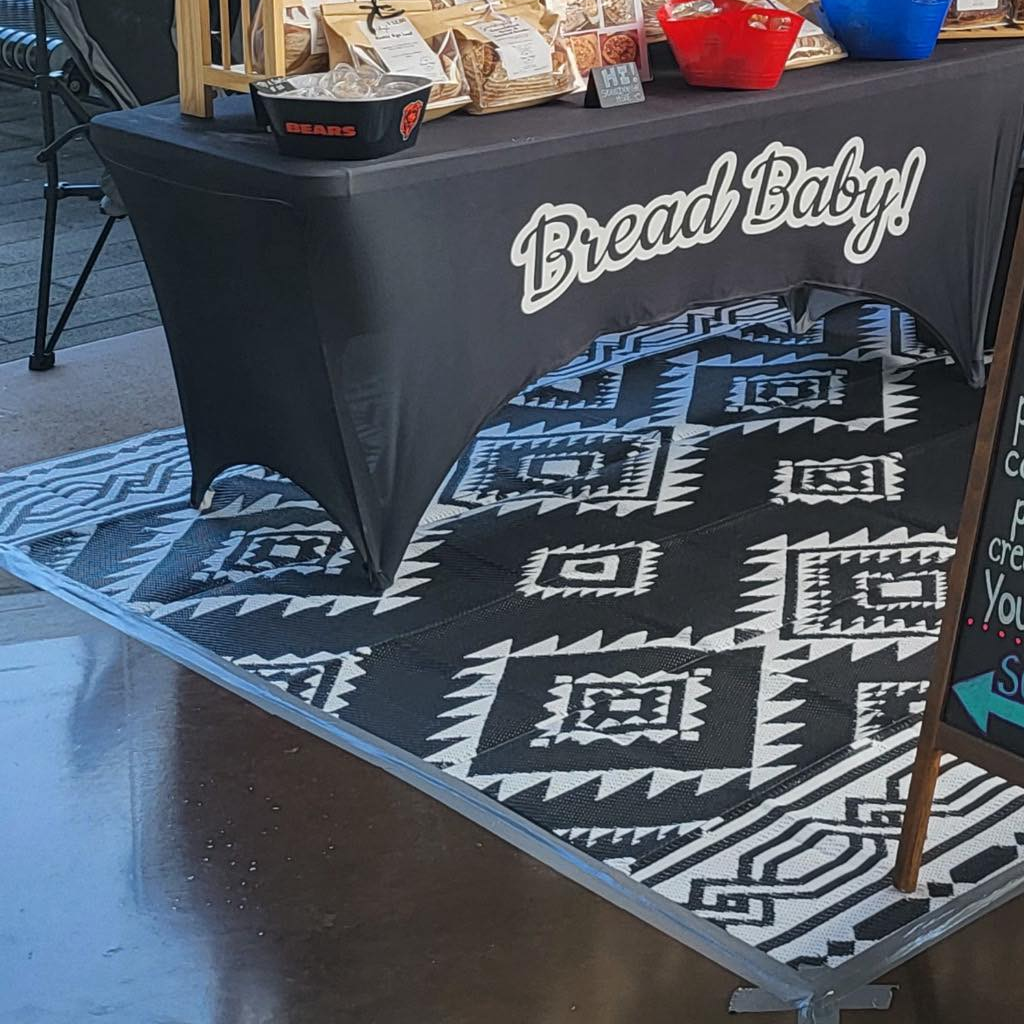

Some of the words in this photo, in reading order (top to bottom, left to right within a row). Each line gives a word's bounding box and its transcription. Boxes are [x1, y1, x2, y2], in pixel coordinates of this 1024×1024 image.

[285, 121, 358, 137] BEARS
[511, 151, 741, 314] Bread
[741, 136, 927, 264] Baby!
